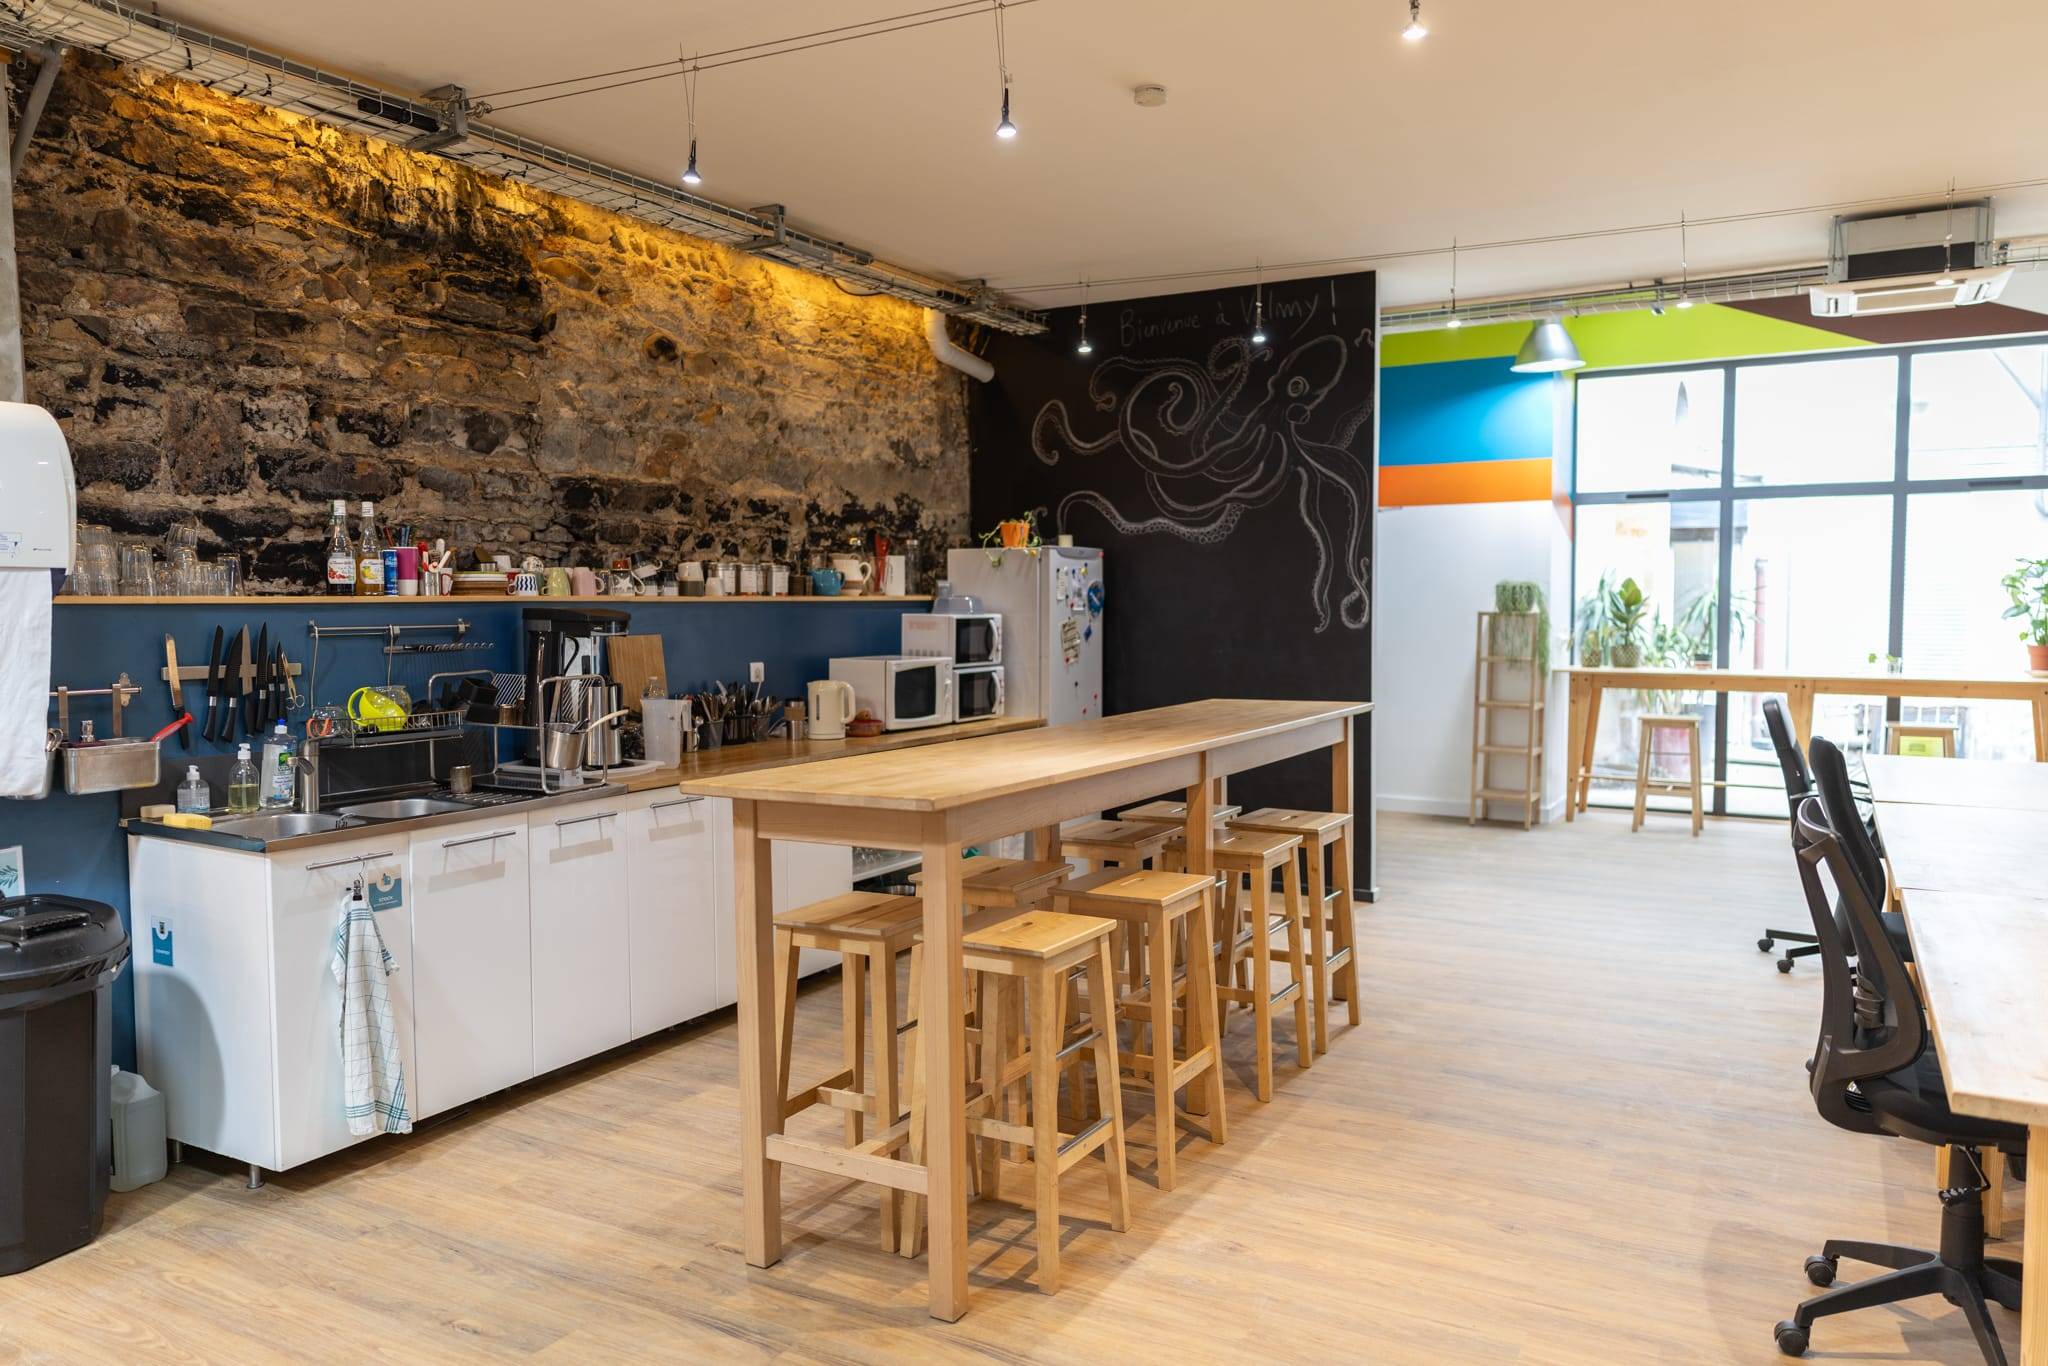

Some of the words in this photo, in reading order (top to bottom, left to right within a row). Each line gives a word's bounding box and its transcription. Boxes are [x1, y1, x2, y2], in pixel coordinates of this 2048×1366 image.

[1119, 308, 1201, 347] Bienvenue
[1215, 300, 1231, 326] à
[1239, 289, 1319, 340] Vlmy
